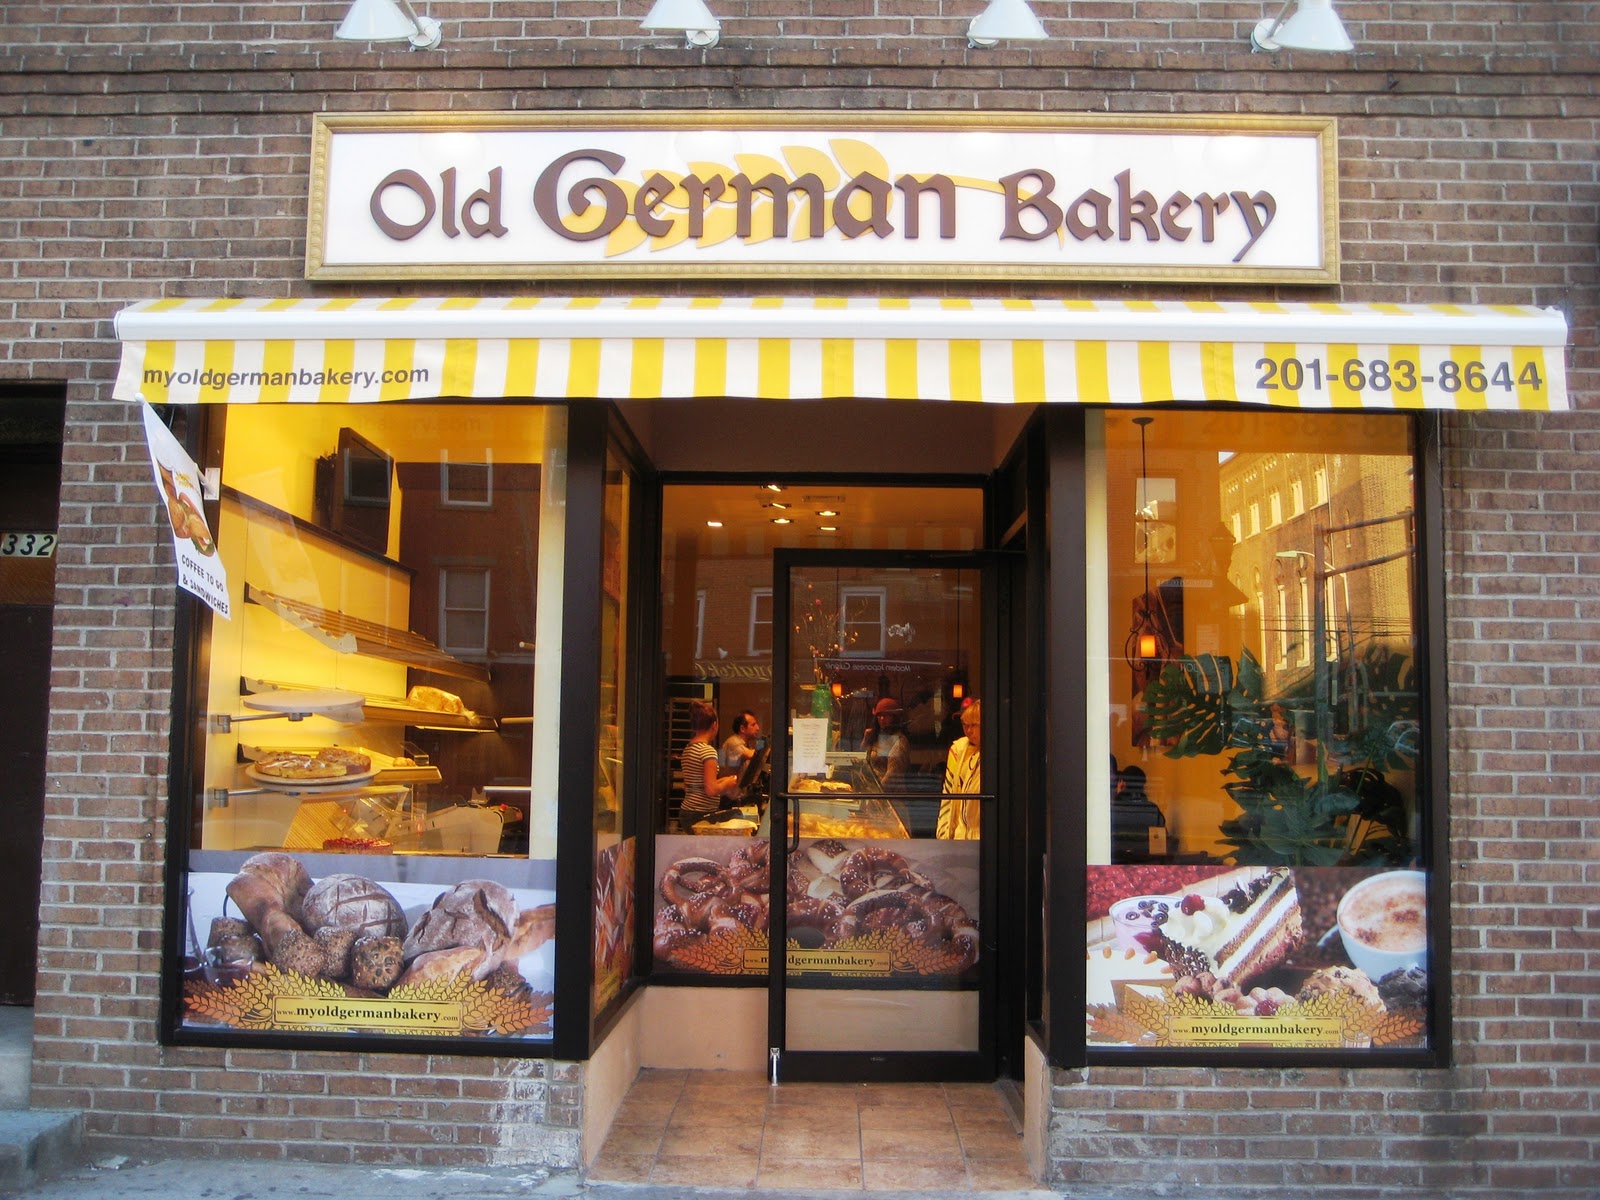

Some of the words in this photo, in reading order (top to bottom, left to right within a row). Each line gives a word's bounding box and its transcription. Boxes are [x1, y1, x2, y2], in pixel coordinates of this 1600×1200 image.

[369, 165, 509, 241] Old
[533, 148, 956, 243] German
[998, 167, 1277, 263] Bakery
[143, 368, 430, 390] myoldgermanbakery.com
[1254, 357, 1543, 393] 201-683-8644
[2, 533, 54, 556] 332
[182, 554, 204, 578] COFFEE
[206, 572, 214, 585] TO
[215, 579, 223, 592] GO
[182, 573, 189, 585] &
[190, 580, 228, 614] SANDWICHES
[276, 1005, 459, 1023] www.myoldgermanbakery.com
[1173, 1023, 1339, 1037] www.myoldgermanbakery.com
